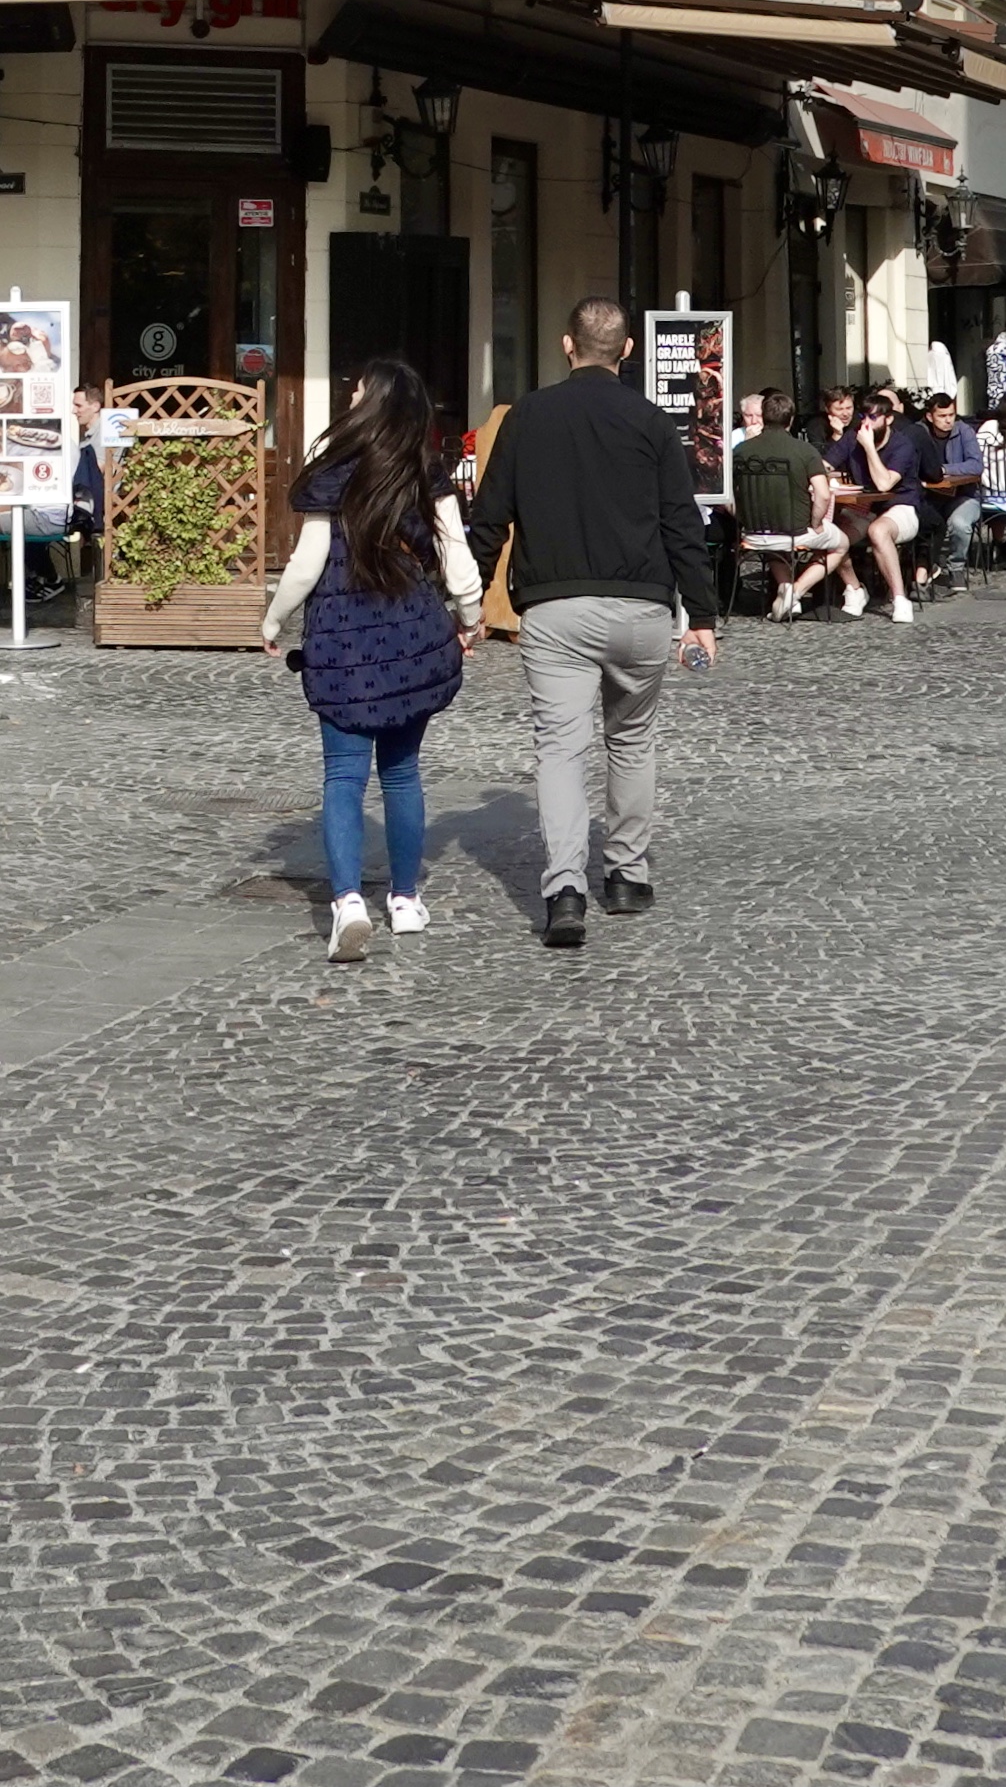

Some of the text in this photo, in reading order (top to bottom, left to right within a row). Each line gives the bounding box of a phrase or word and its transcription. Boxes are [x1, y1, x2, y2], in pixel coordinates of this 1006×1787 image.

[657, 334, 695, 346] MARELE
[132, 364, 156, 379] city
[657, 361, 672, 373] NU
[657, 394, 672, 407] NU
[137, 421, 220, 436] Welcome
